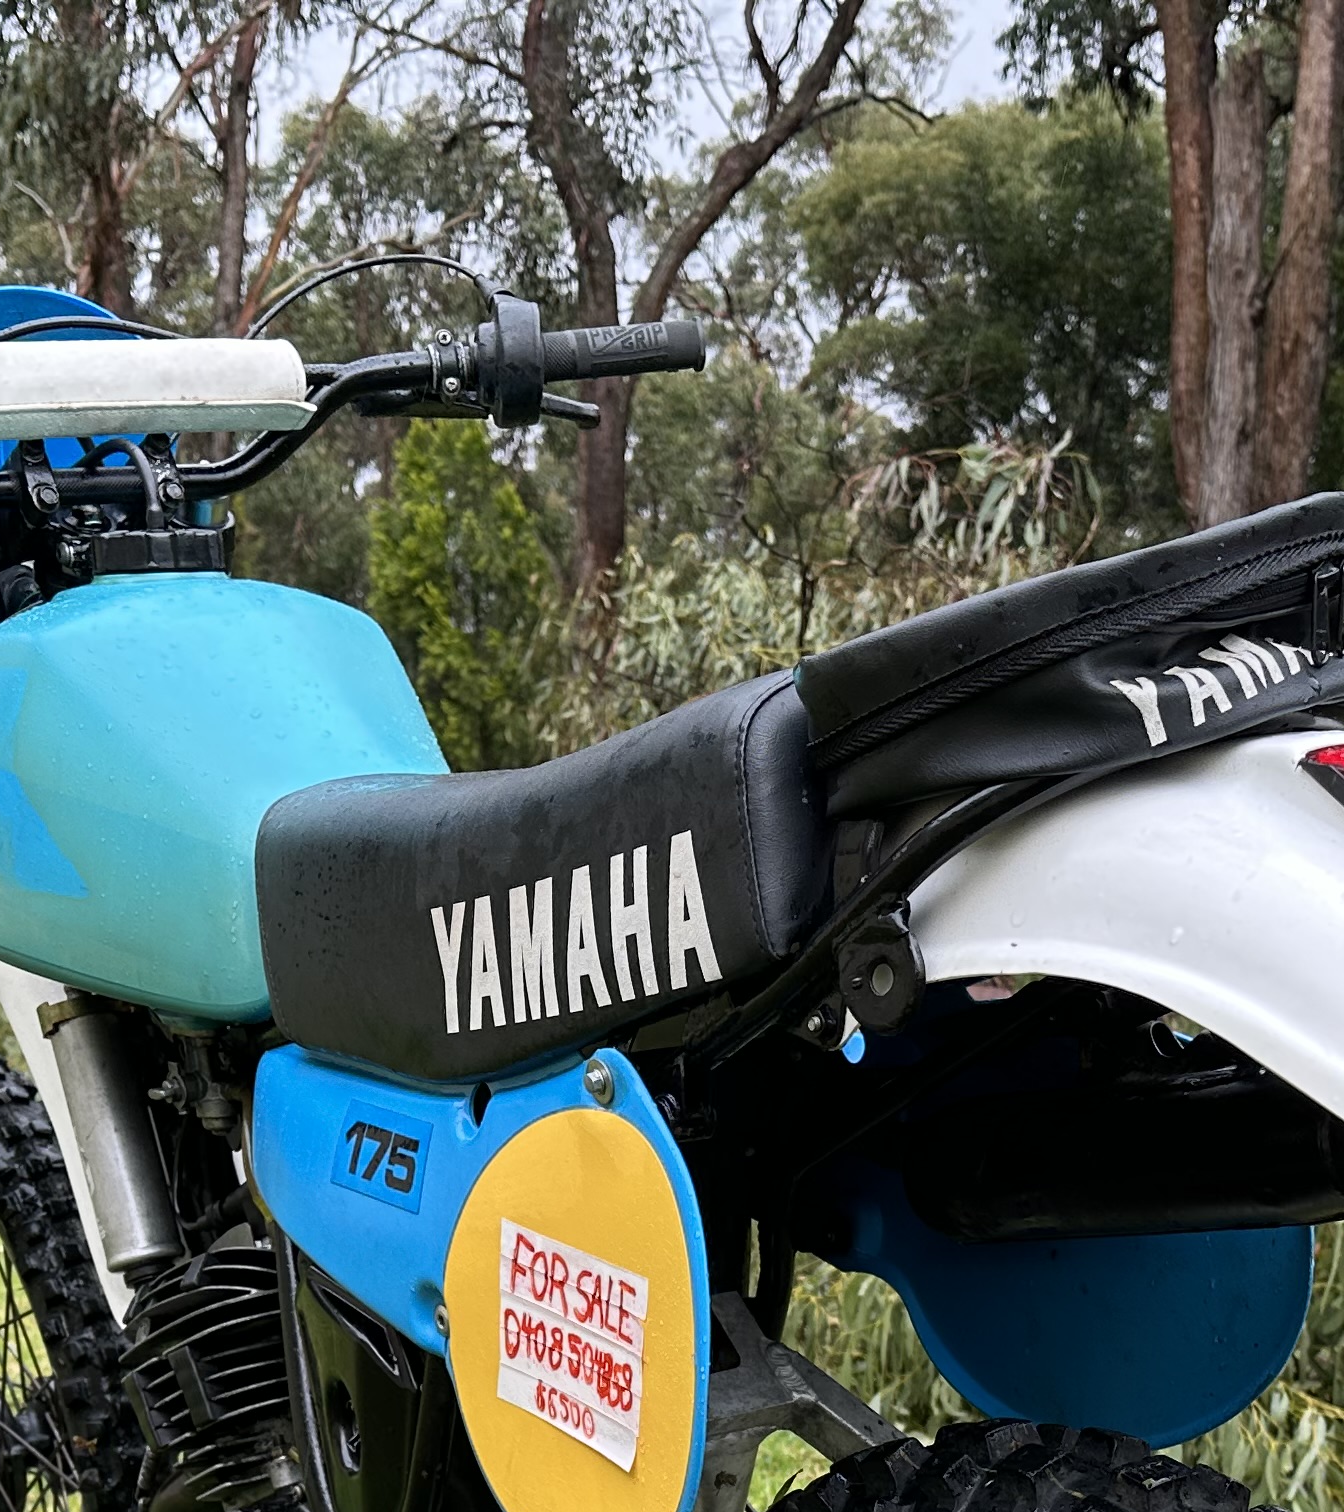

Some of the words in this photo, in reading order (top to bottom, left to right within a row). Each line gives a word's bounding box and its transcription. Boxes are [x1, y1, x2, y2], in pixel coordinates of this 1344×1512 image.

[621, 324, 665, 351] GRIP
[430, 829, 724, 1035] YAMAHA
[346, 1120, 420, 1194] 175
[511, 1232, 569, 1318] FOR
[573, 1269, 636, 1345] SALE
